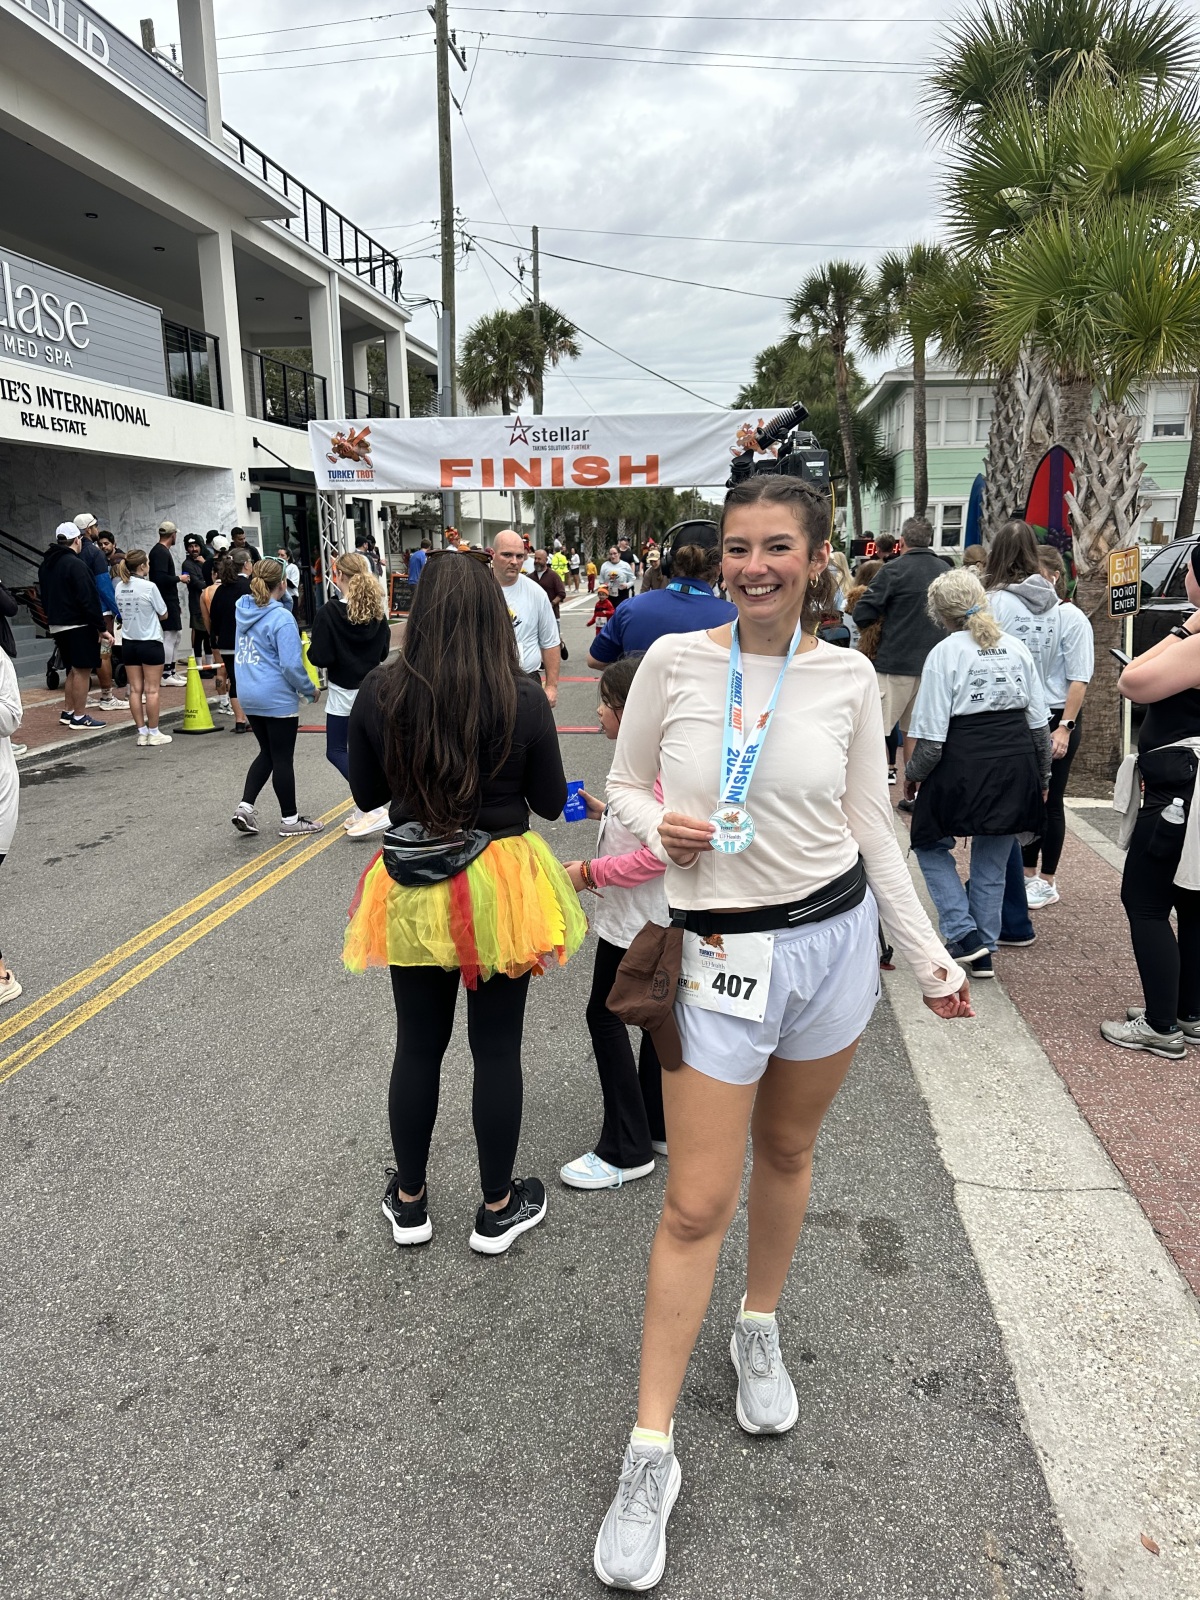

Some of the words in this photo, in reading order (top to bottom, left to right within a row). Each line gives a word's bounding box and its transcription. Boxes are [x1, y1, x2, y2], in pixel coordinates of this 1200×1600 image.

[0, 261, 90, 349] lase
[3, 334, 38, 358] MED
[44, 345, 73, 368] SPA
[36, 386, 150, 427] INTERNATIONAL
[21, 411, 49, 430] REAL
[51, 416, 88, 435] ESTATE
[532, 427, 590, 443] stellar
[240, 472, 247, 481] 42
[327, 469, 355, 479] TURKEY
[356, 469, 374, 479] TROT
[440, 455, 659, 488] FINISH
[1115, 555, 1136, 571] EXIT
[1112, 569, 1137, 584] ONLY
[1112, 588, 1124, 599] DO
[1124, 585, 1137, 596] NOT
[1114, 597, 1136, 610] ENTER
[734, 671, 743, 707] TURKEY
[732, 707, 743, 731] TROT
[725, 746, 741, 784] 202
[712, 972, 758, 1001] 407
